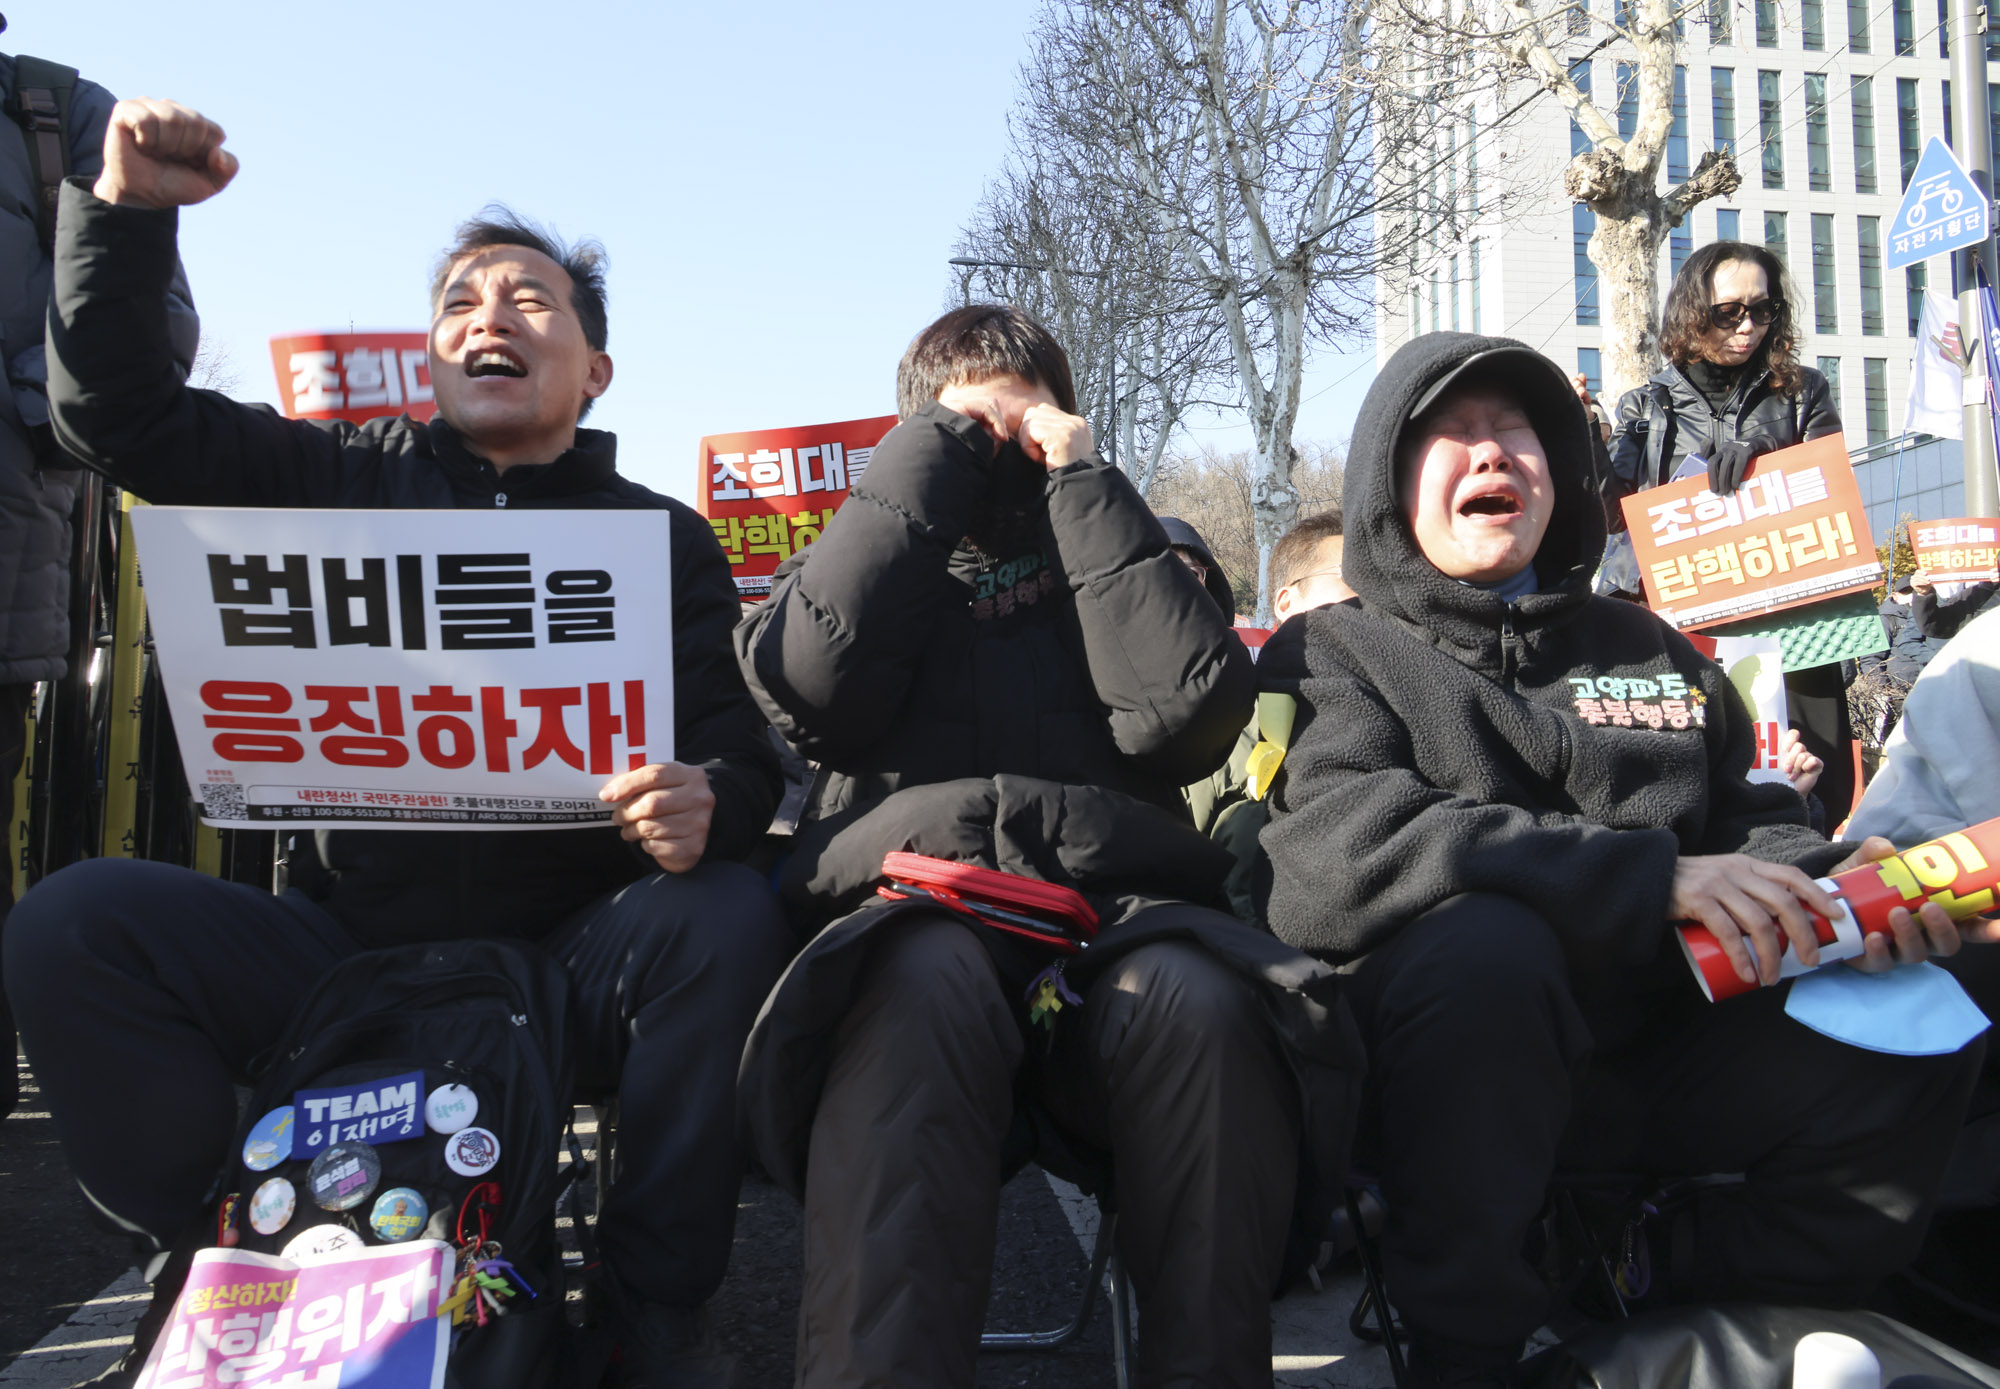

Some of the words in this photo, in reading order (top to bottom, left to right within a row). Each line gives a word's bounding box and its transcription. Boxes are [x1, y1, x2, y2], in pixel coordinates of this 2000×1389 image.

[1894, 212, 1981, 254] 자전거횡단
[1648, 466, 1831, 547] 조희대를
[1650, 511, 1859, 603] 탄핵하라!
[206, 552, 616, 650] 법비들을
[1568, 673, 1688, 700] 고양파주
[200, 679, 647, 775] 응징하자!
[1574, 698, 1691, 730] 촛불행동
[297, 789, 358, 803] 내란청산!
[361, 792, 448, 807] 국민주권실현!
[452, 796, 547, 810] 촛불대행진으로
[551, 800, 596, 811] 모이자!
[303, 1081, 417, 1124] TEAM
[306, 1103, 416, 1147] 이재명
[185, 1277, 299, 1315] 청산하자!
